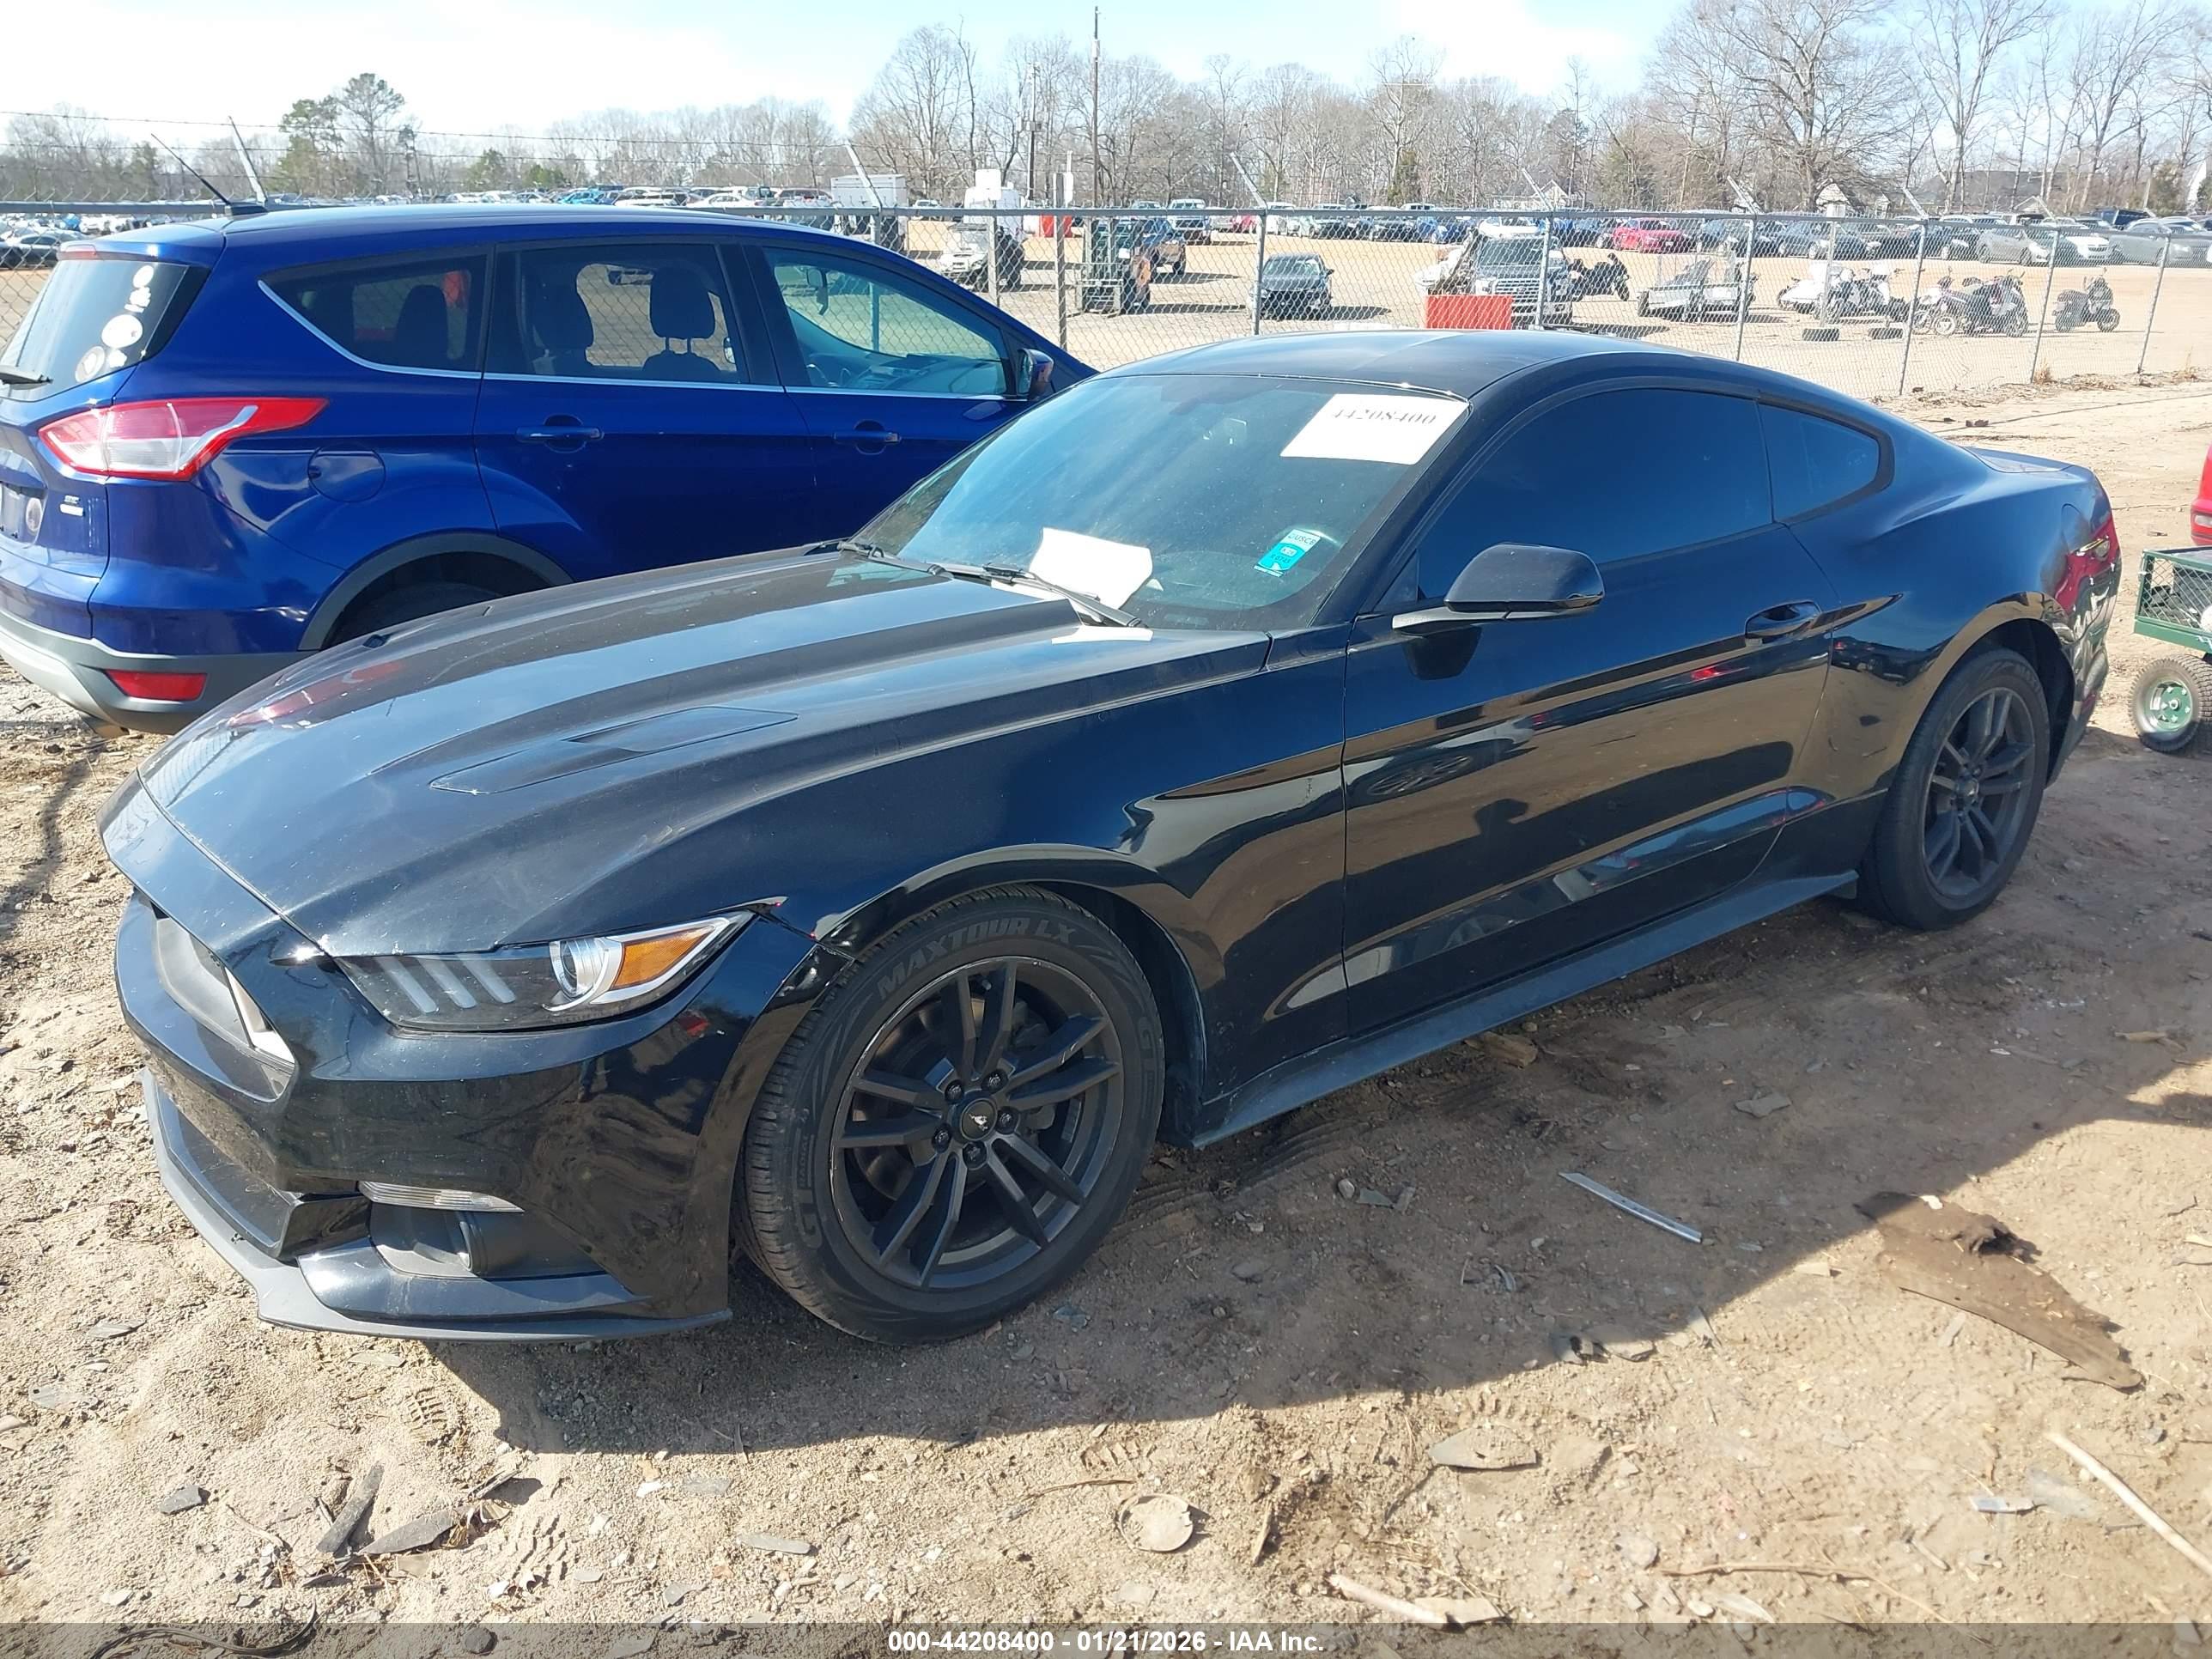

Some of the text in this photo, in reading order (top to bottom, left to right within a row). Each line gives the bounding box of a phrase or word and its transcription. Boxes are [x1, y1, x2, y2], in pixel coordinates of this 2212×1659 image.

[1333, 409, 1437, 424] 44208400
[877, 916, 1077, 1000] MAXTOUR LX
